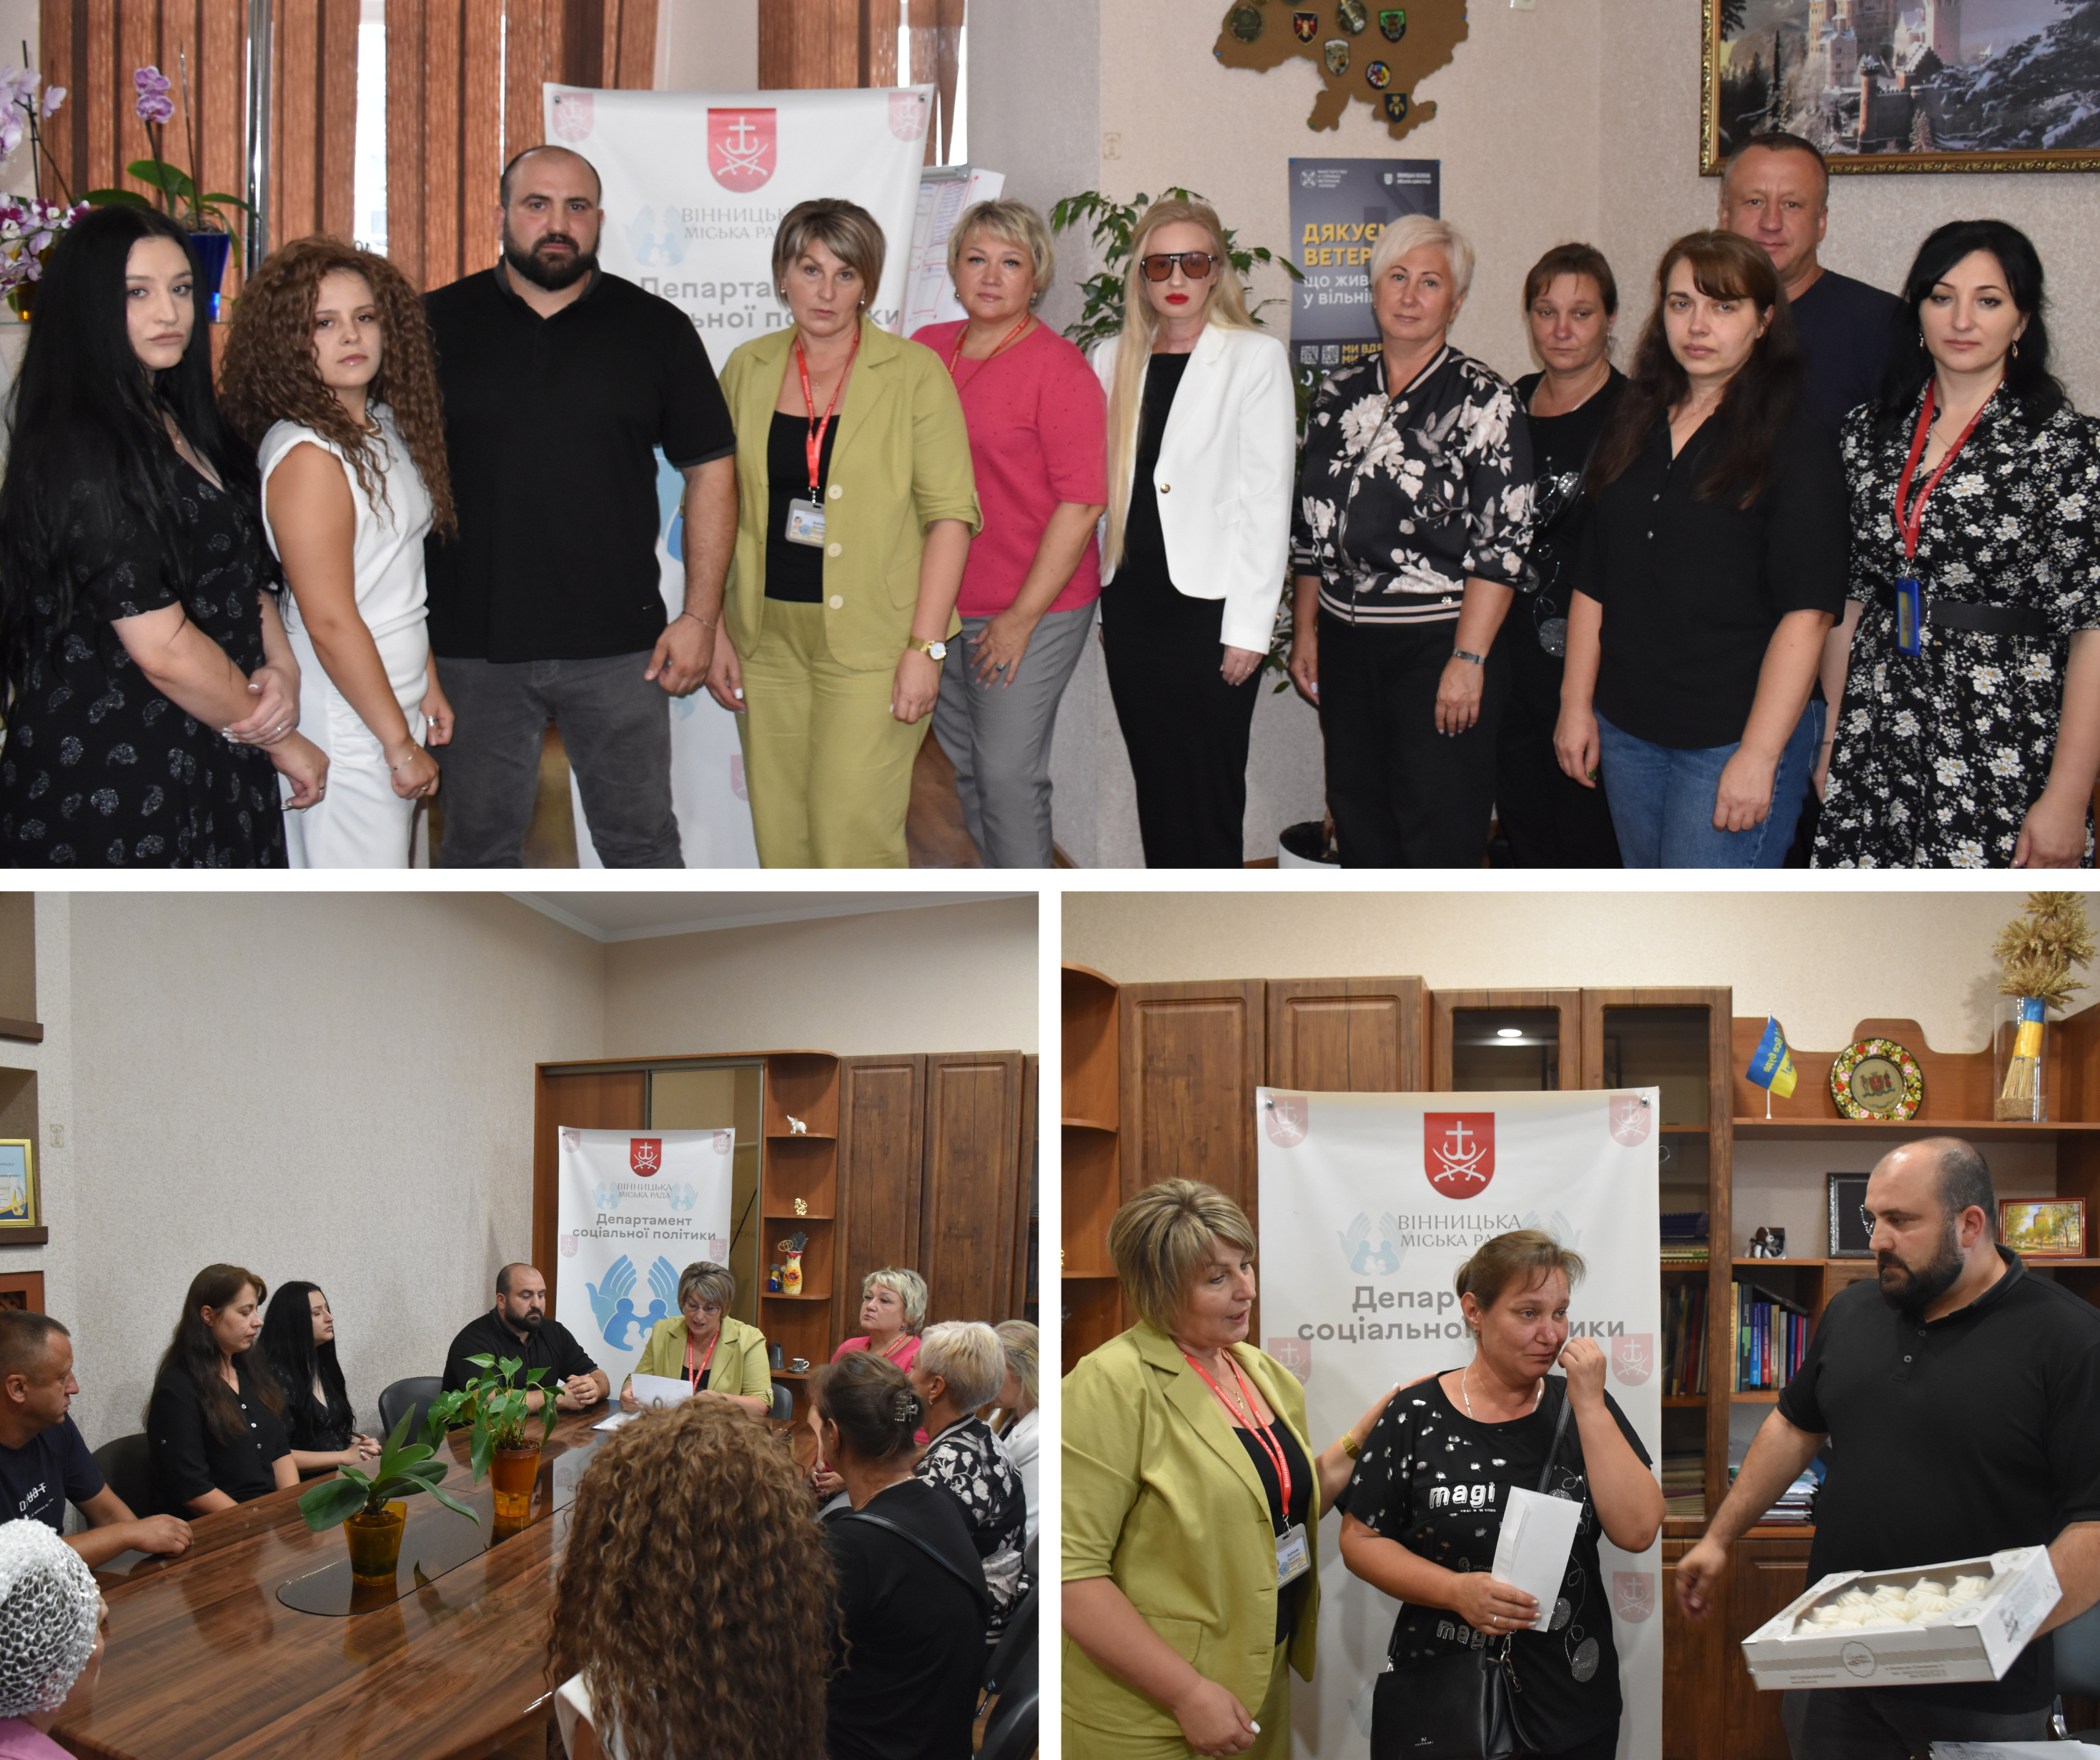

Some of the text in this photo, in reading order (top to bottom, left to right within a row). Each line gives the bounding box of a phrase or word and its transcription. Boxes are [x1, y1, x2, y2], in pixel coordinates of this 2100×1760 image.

[682, 208, 789, 224] ВІННИЦЬК
[684, 227, 776, 239] МІСЬКА РА
[1302, 223, 1385, 245] ДЯКУЄ
[1304, 247, 1372, 267] ВЕТЕР
[1334, 274, 1370, 287] жив
[640, 277, 771, 305] Департа
[1303, 294, 1314, 309] у
[1361, 344, 1384, 354] ВДЯ
[618, 1183, 672, 1191] ВІННИЦЬКА
[596, 1213, 692, 1228] Департамент
[1398, 1214, 1521, 1232] ВІННИЦЬКА
[573, 1226, 715, 1241] соціальної політики
[1400, 1234, 1468, 1248] МІСЬКА
[1215, 1386, 1274, 1457] ВІННИЦЬКА МІСЬКА РАДА
[1429, 1481, 1495, 1509] magi
